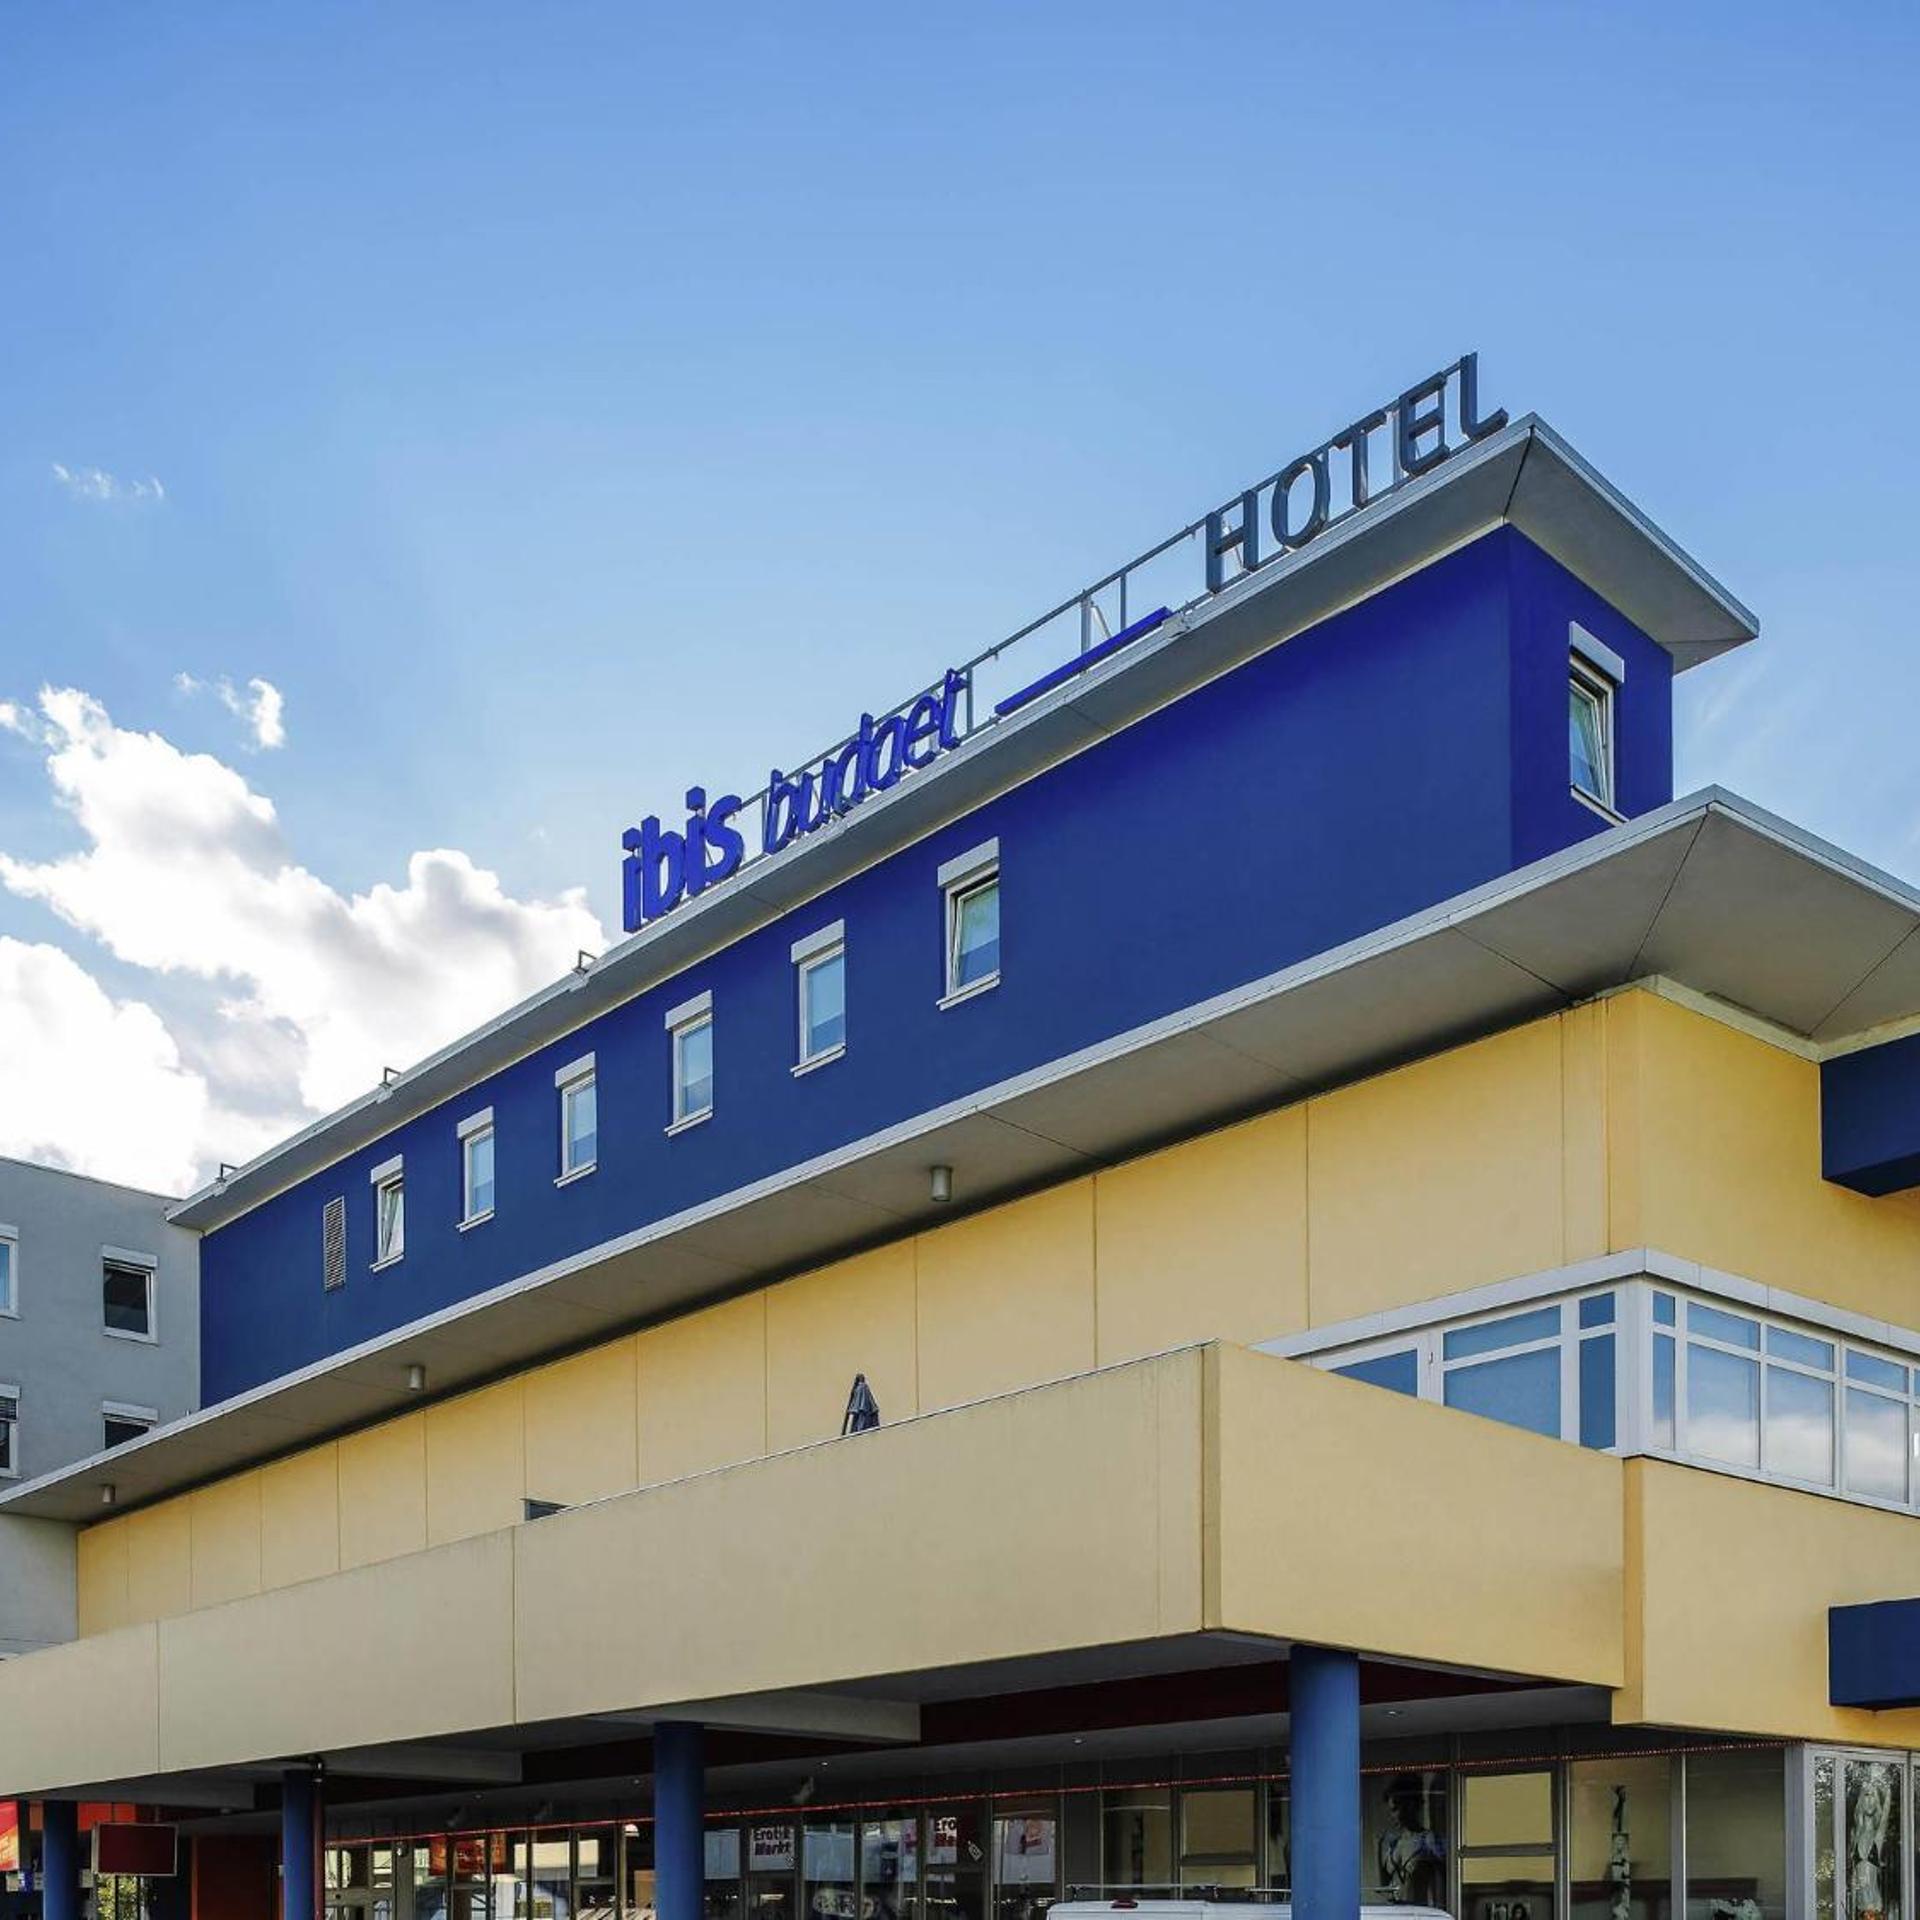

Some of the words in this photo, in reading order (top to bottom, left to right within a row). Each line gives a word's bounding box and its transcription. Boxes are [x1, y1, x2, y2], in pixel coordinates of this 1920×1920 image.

[622, 785, 744, 933] ibis
[762, 668, 969, 857] budget
[1205, 351, 1509, 594] HOTEL
